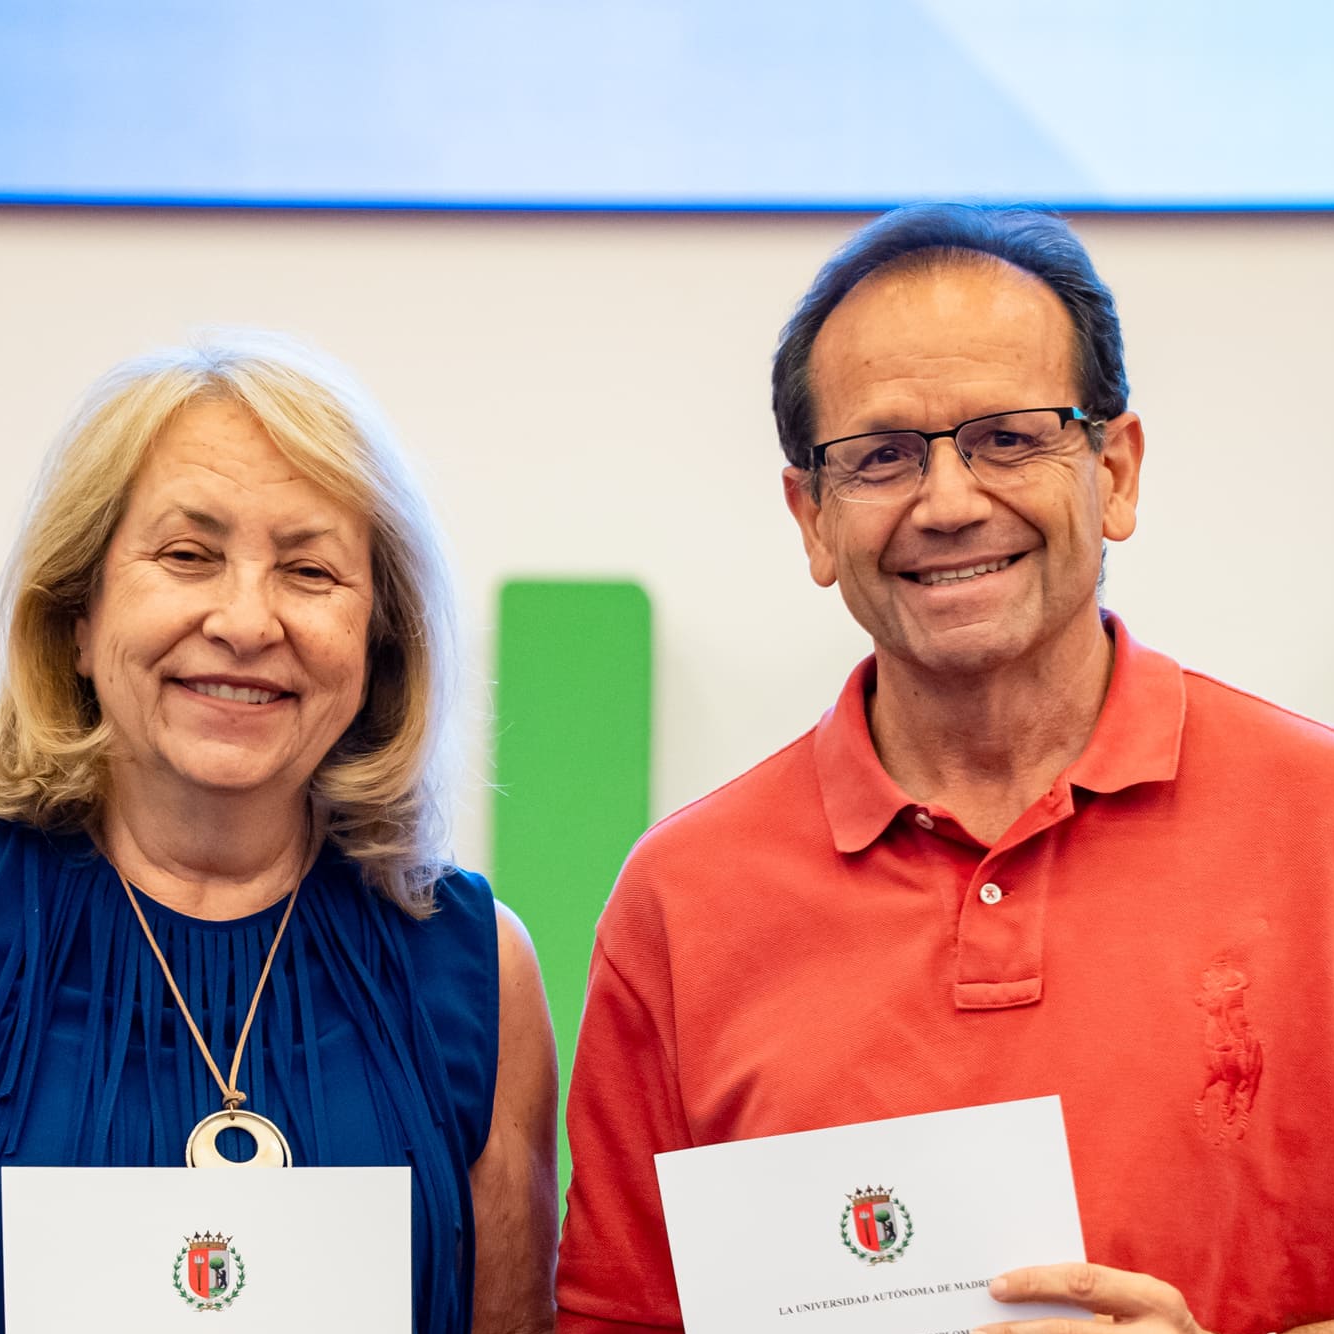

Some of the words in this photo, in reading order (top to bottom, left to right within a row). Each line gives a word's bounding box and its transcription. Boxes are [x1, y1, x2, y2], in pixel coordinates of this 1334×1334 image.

[779, 1306, 794, 1316] LA
[795, 1294, 870, 1313] UNIVERSIDAD
[872, 1286, 935, 1302] AUTÓNOMA
[937, 1283, 951, 1294] DE
[954, 1278, 990, 1291] MADRI
